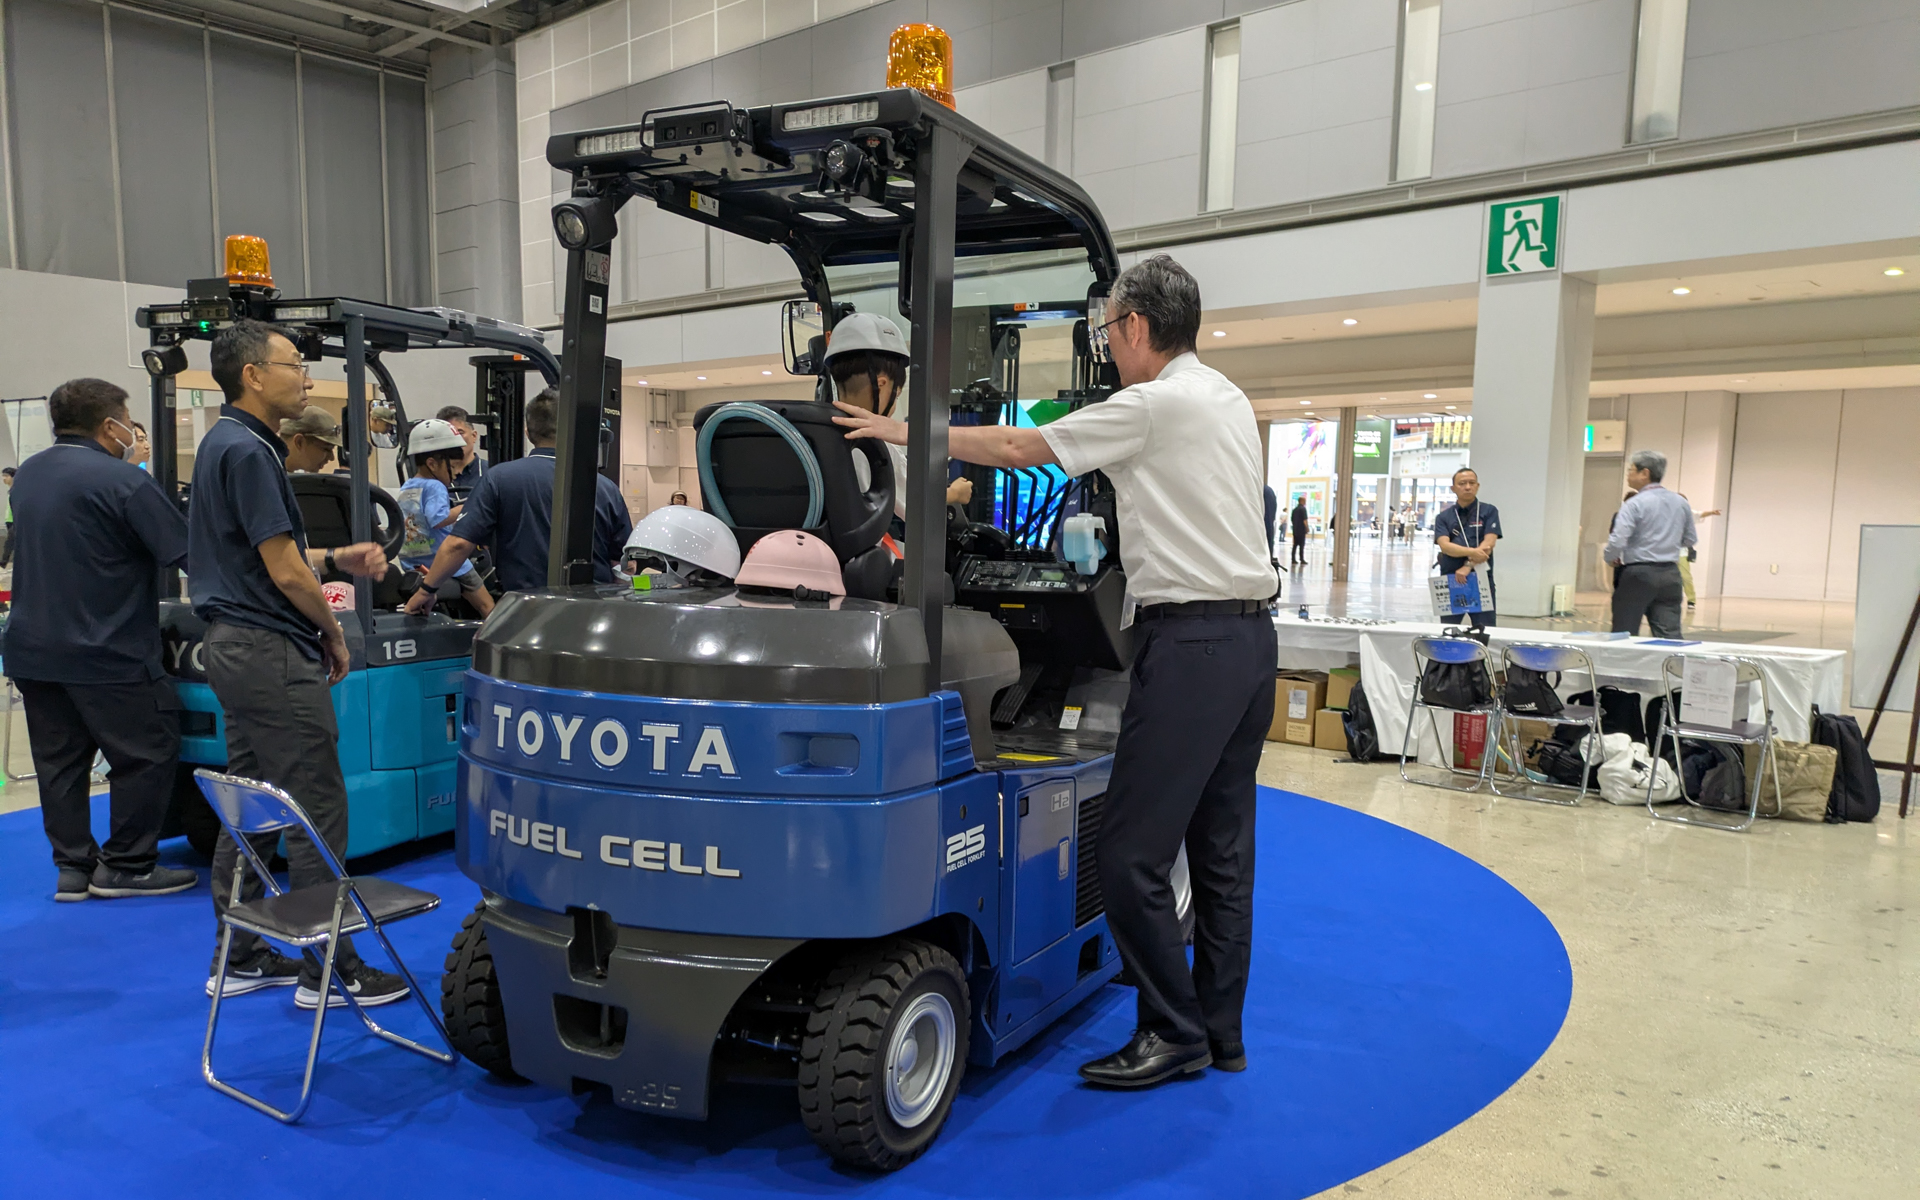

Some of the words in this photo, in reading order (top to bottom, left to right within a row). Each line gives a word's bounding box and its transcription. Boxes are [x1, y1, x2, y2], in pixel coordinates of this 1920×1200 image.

[604, 407, 620, 416] TOYOTA
[323, 584, 348, 595] OYOTA
[382, 639, 417, 660] 18
[494, 704, 736, 775] TOYOTA
[490, 809, 582, 859] FUEL
[600, 835, 740, 877] CELL
[946, 824, 985, 864] 25
[947, 863, 957, 873] FUEL
[957, 859, 967, 868] CELL
[968, 850, 986, 864] FORKLIFT
